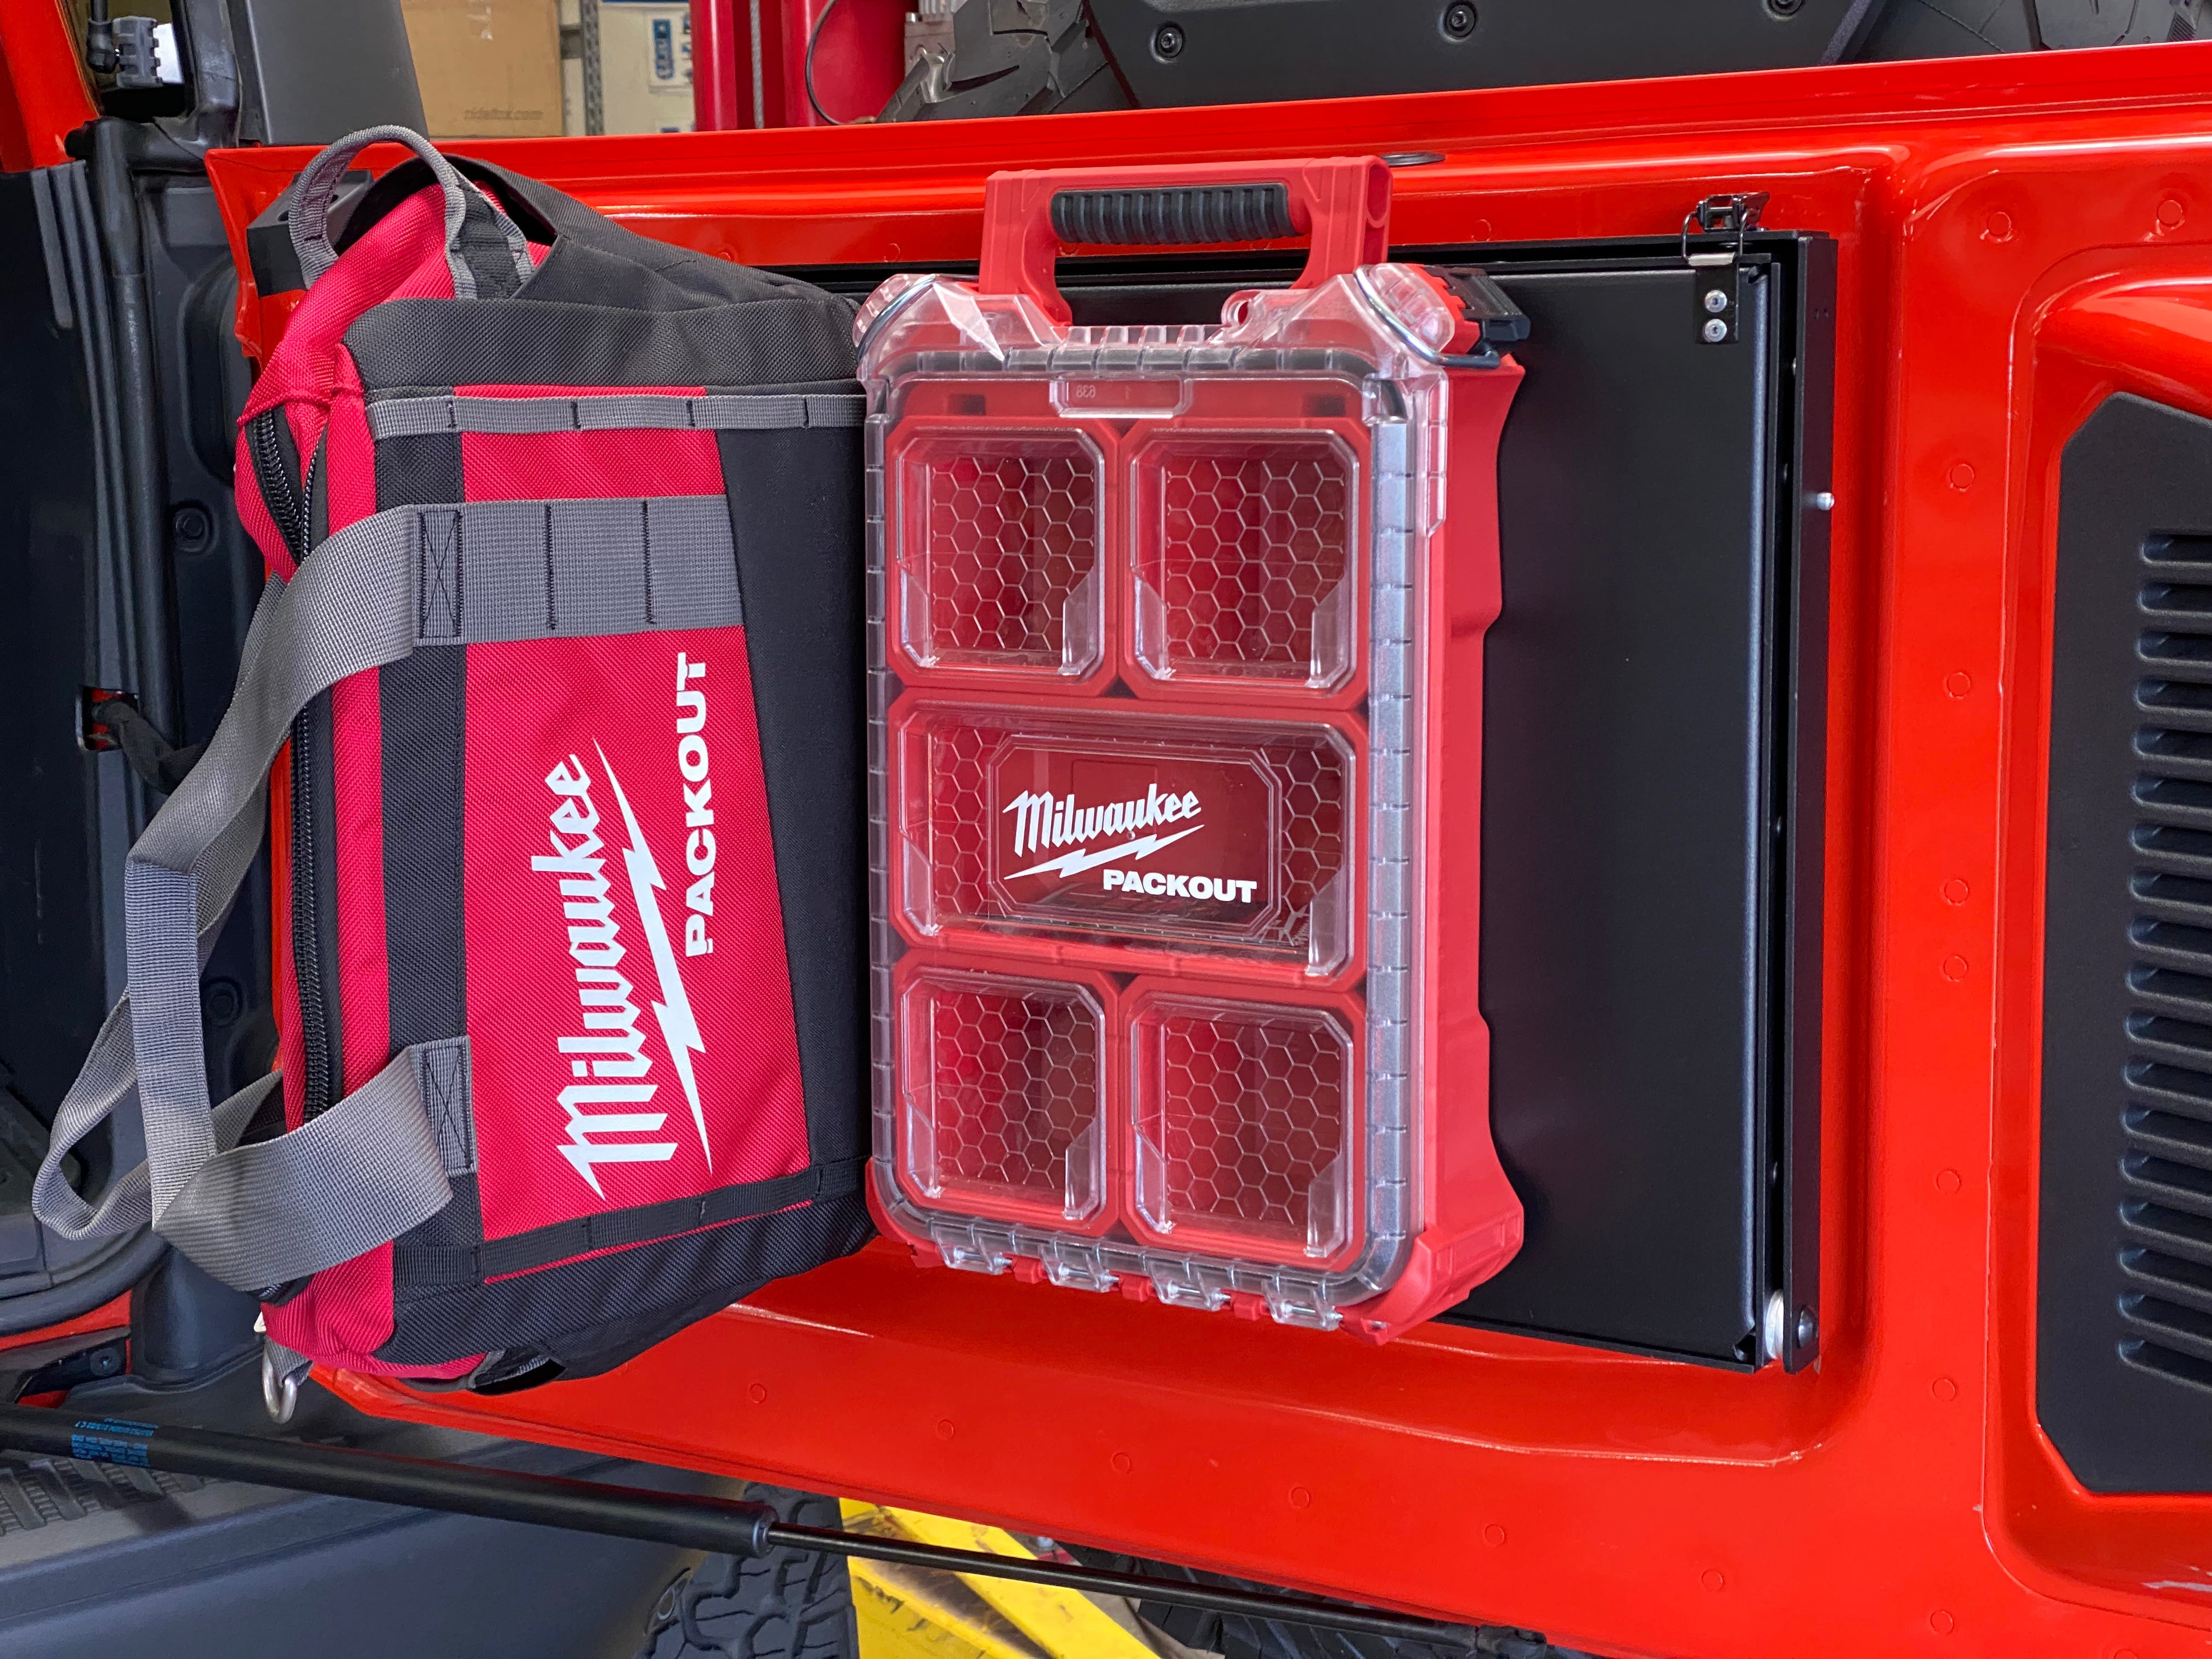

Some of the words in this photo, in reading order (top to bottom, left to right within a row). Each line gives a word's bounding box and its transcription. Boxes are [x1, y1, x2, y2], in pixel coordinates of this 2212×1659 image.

[676, 652, 714, 957] PACKOUT
[1003, 783, 1201, 857] Milwaukee
[1103, 870, 1257, 903] PACKOUT
[531, 754, 679, 1201] Milwaukee
